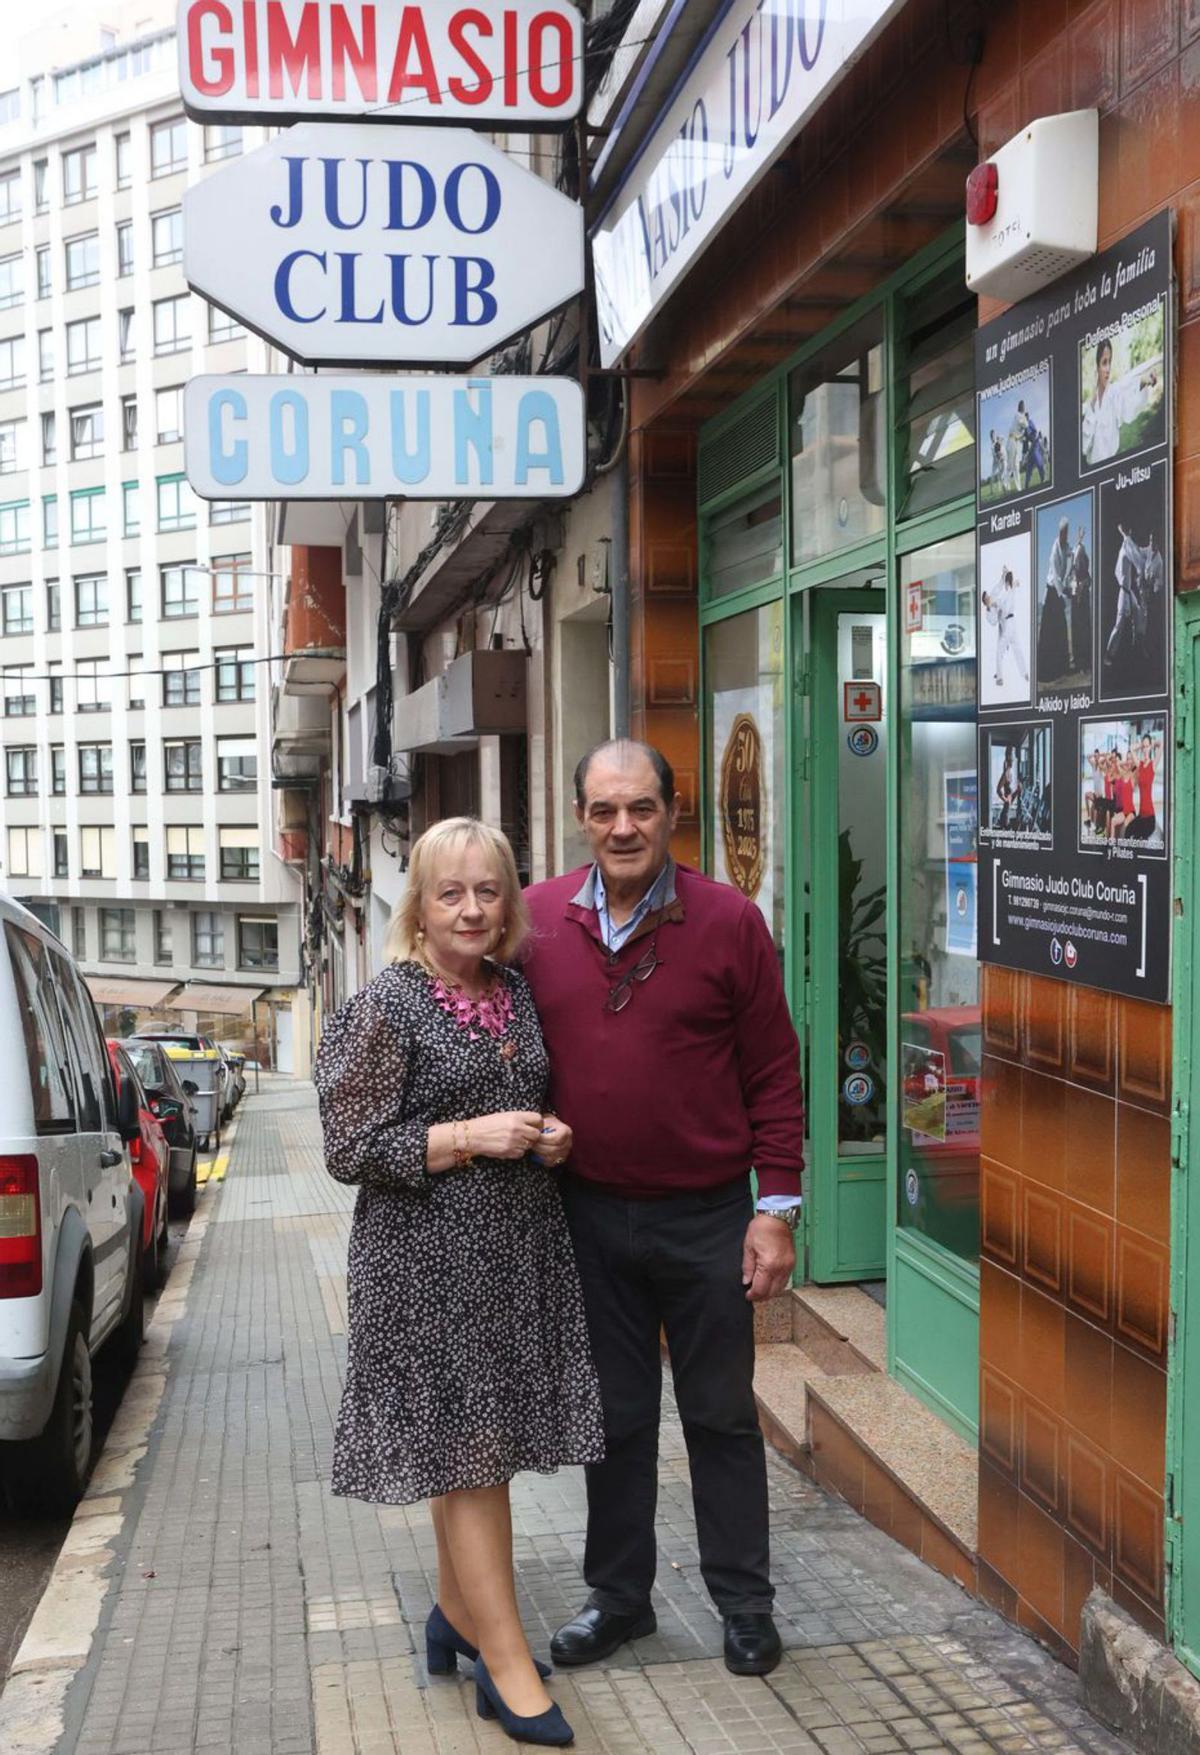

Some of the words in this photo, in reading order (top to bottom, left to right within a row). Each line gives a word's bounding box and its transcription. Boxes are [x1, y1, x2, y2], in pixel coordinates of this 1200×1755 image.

[187, 0, 574, 108] GIMNASIO
[269, 157, 502, 234] JUDO
[273, 250, 499, 326] CLUB
[985, 340, 998, 363] un
[999, 315, 1045, 362] gimnasio
[1046, 300, 1071, 337] para
[1074, 283, 1097, 314] toda
[1100, 272, 1111, 298] la
[1113, 247, 1156, 299] familia
[1085, 319, 1120, 350] Defensa
[1121, 293, 1160, 328] Personal
[208, 380, 565, 487] CORUÑA
[1115, 466, 1151, 490] Ju-Jitsu
[990, 509, 1021, 533] Karate
[1038, 695, 1063, 712] Aikido
[1063, 698, 1070, 715] y
[736, 729, 755, 773] 50
[1112, 847, 1134, 860] Pilates
[1001, 870, 1044, 892] Gimnasio
[1045, 875, 1070, 896] Judo
[1071, 877, 1094, 899] Club
[1096, 882, 1136, 905] Coruña
